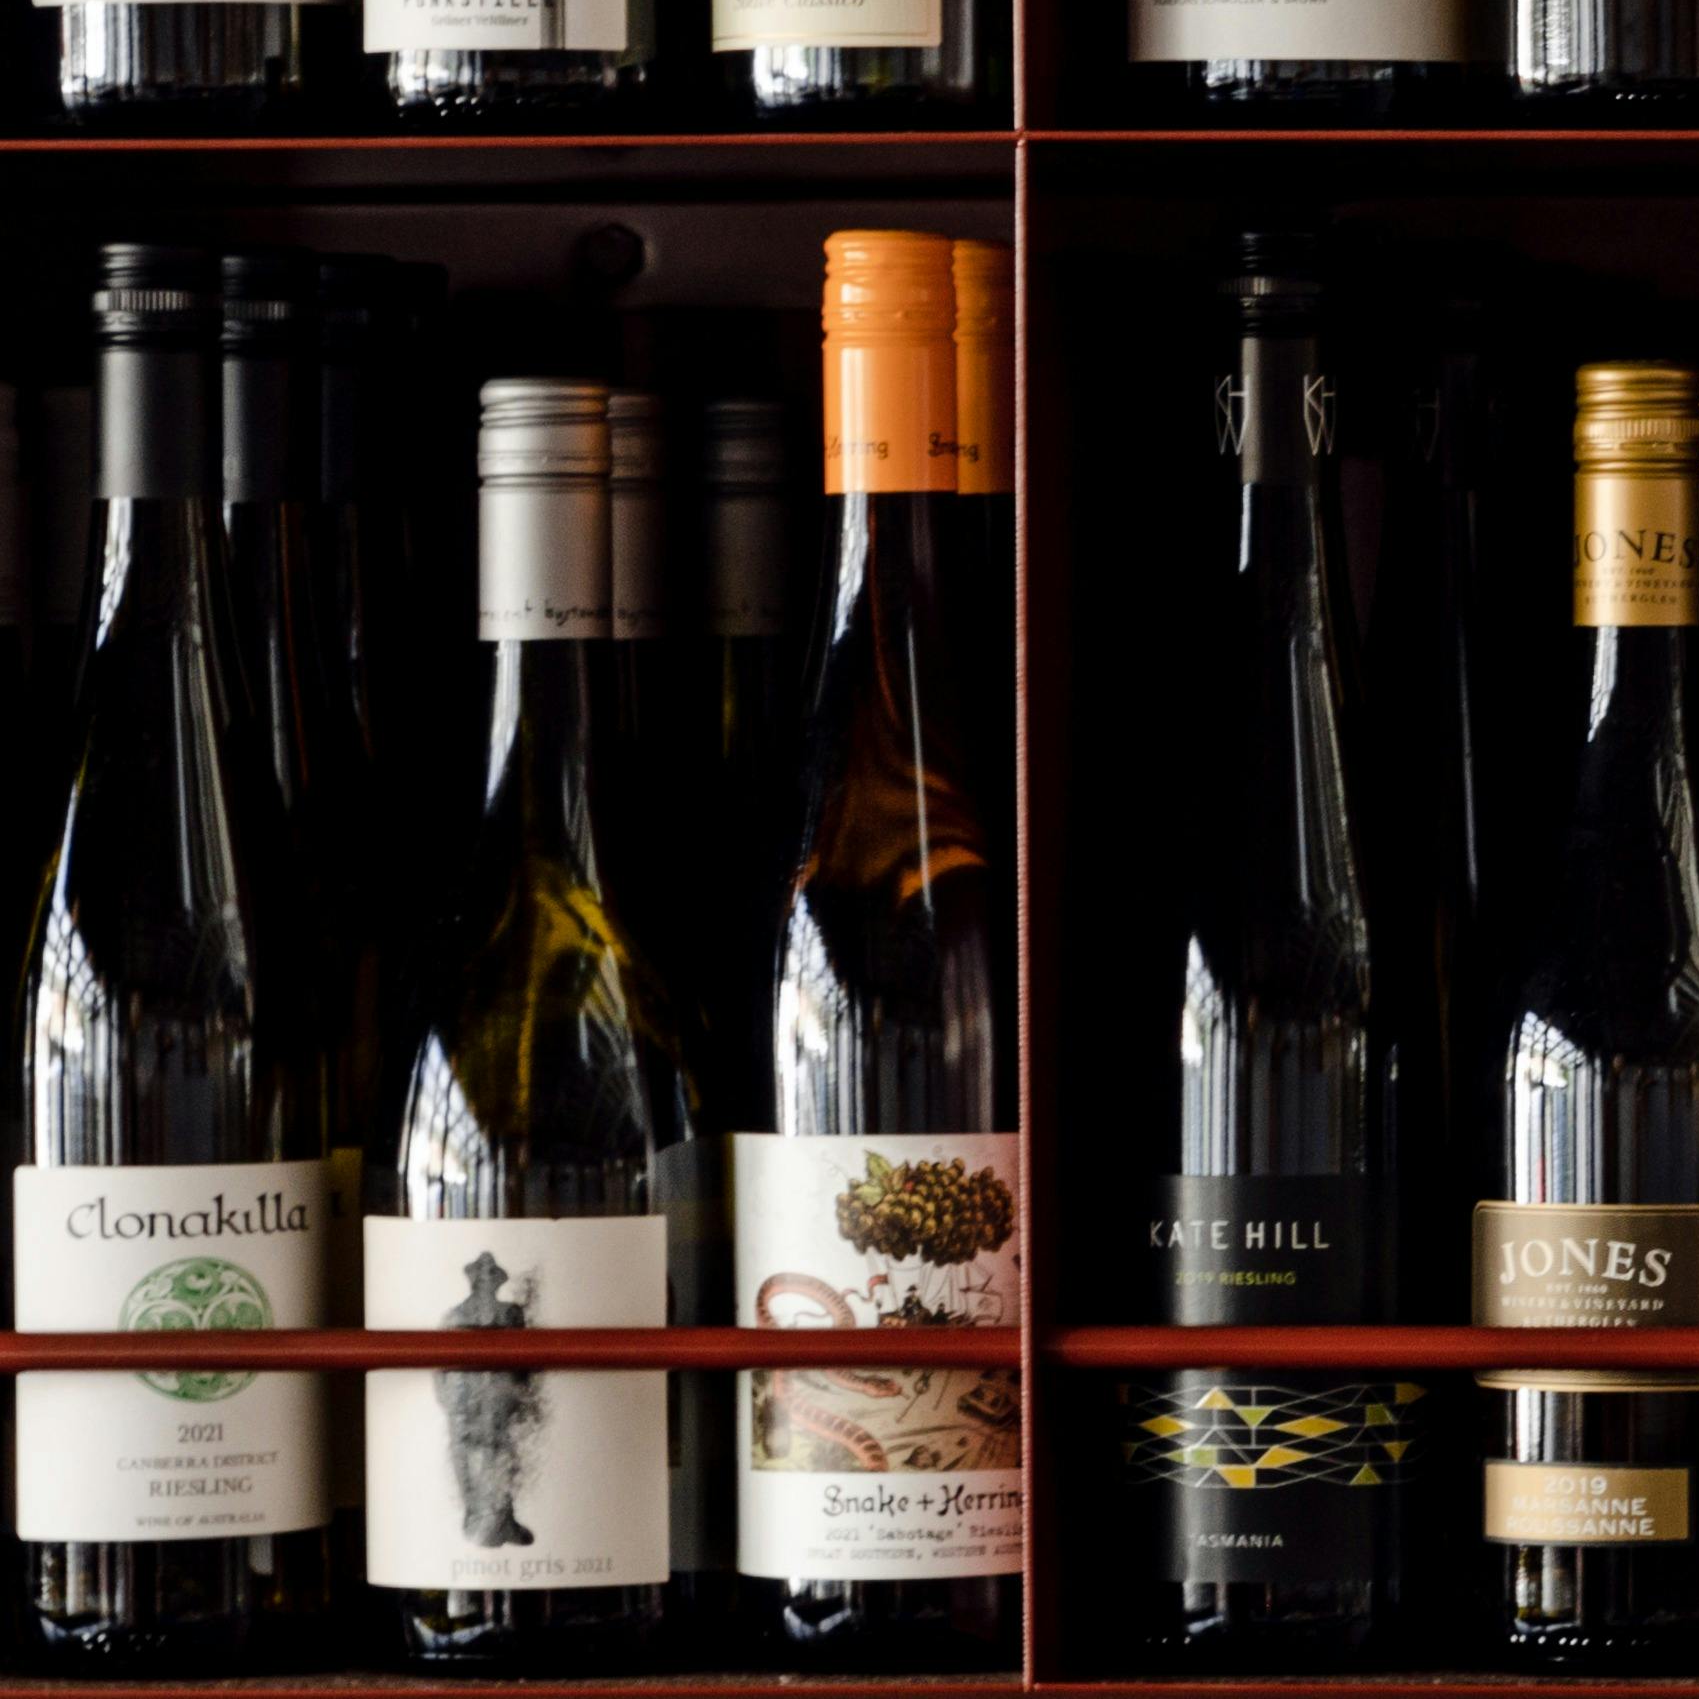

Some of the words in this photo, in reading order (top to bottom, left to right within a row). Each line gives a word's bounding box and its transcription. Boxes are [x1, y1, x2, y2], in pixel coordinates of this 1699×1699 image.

[67, 1192, 310, 1240] Clonakilla
[1150, 1220, 1229, 1250] KATE
[1245, 1220, 1330, 1250] HILL
[1500, 1238, 1673, 1288] JONES
[1218, 1270, 1297, 1286] RIESLING
[1573, 1299, 1665, 1312] VINEYARD
[177, 1422, 225, 1443] 2021
[117, 1455, 210, 1471] CANBERRA
[213, 1450, 280, 1469] DISTRICT
[149, 1476, 253, 1499] RIESLING
[1544, 1475, 1608, 1496] 2019
[822, 1484, 910, 1517] Snake
[1513, 1497, 1648, 1517] MARSANNE
[1507, 1518, 1655, 1537] ROUSSANNE
[1190, 1533, 1284, 1549] TASMANIA
[452, 1552, 511, 1581] pinot
[520, 1552, 566, 1581] gris
